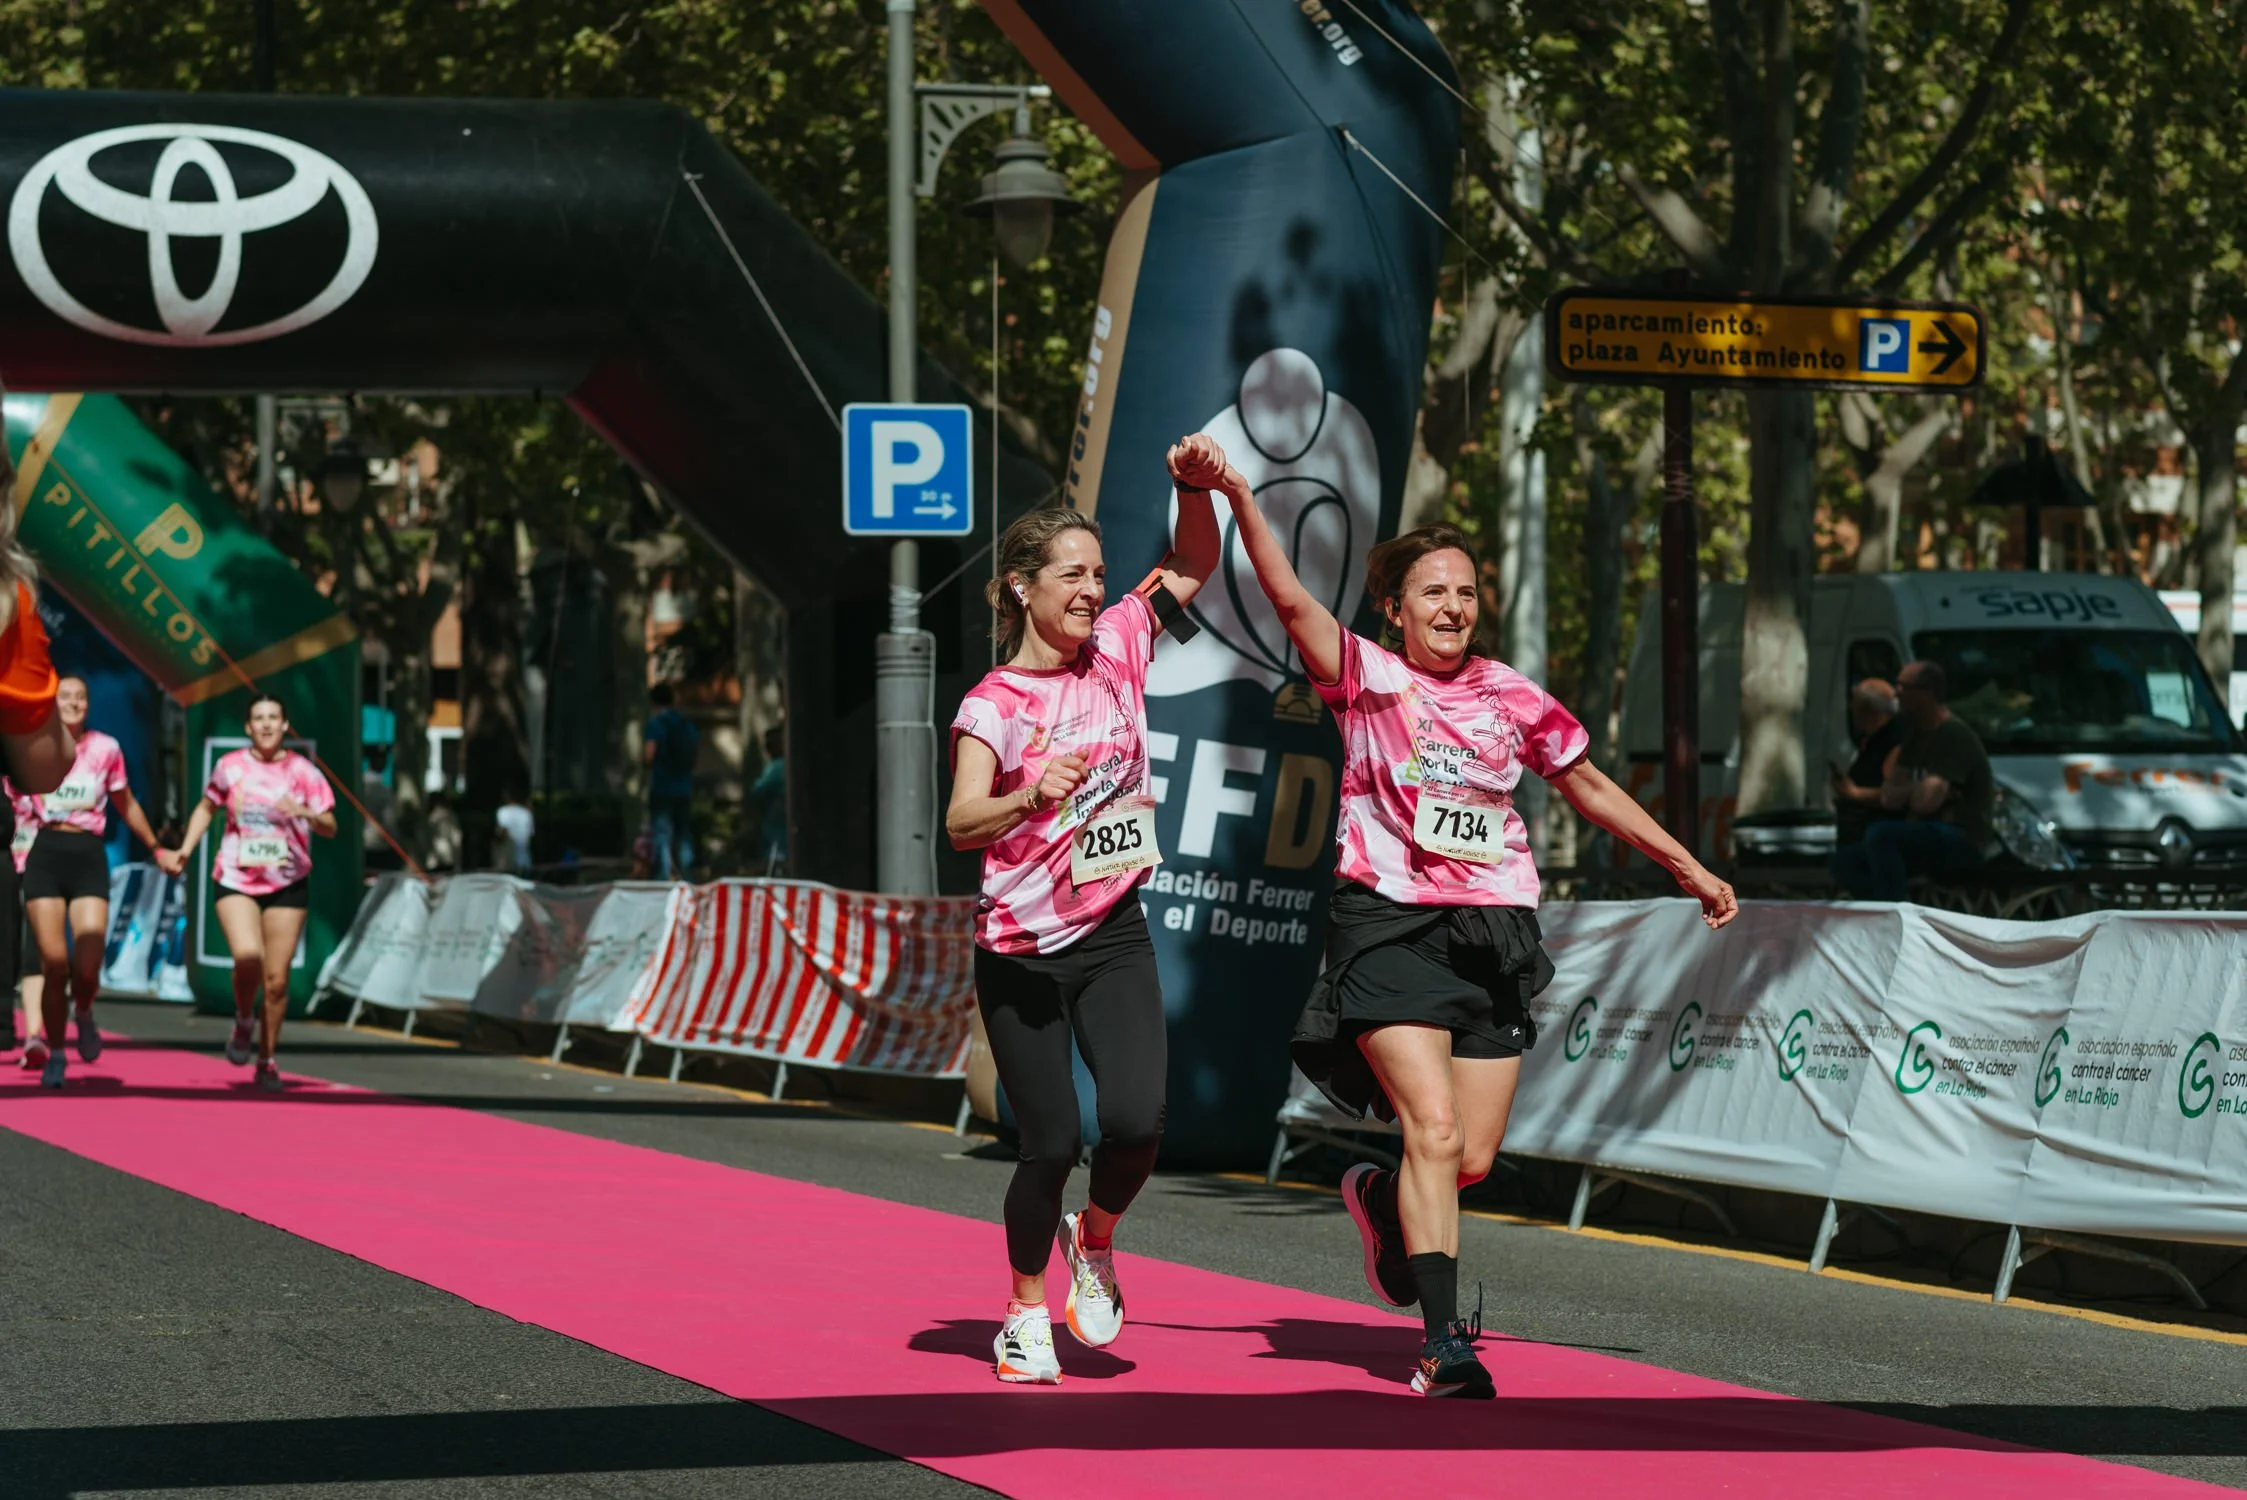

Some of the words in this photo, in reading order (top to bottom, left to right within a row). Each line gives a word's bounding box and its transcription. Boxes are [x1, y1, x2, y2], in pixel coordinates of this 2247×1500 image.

[1301, 0, 1363, 66] er.org
[1568, 311, 1763, 338] aparcamiento:
[1568, 339, 1639, 365] plaza
[1657, 341, 1846, 371] Ayuntamiento
[1867, 322, 1901, 369] P
[871, 420, 945, 518] P
[43, 482, 217, 665] PITILLOS
[1417, 717, 1433, 732] XI
[1417, 736, 1476, 759] Carrera
[1087, 754, 1121, 780] rrera
[1444, 759, 1458, 775] la
[1074, 786, 1099, 807] por
[1101, 780, 1115, 793] la
[1432, 806, 1488, 842] 7134
[1083, 818, 1142, 860] 2825
[1247, 879, 1315, 910] Ferrer
[1163, 903, 1196, 932] el
[1210, 907, 1308, 945] Deporte
[1948, 1033, 1998, 1052] asociación
[1999, 1035, 2040, 1056] española
[2077, 1036, 2130, 1057] asociación
[2131, 1038, 2178, 1061] española
[1942, 1056, 1974, 1073] contra
[1975, 1057, 1986, 1075] el
[2071, 1061, 2104, 1079] contra
[2104, 1061, 2115, 1080] el
[1935, 1081, 1950, 1094] en
[1950, 1079, 1964, 1096] La
[1963, 1080, 1987, 1101] Rioja
[2223, 1072, 2247, 1088] con
[2065, 1088, 2077, 1104] en
[2078, 1086, 2093, 1105] La
[2094, 1087, 2119, 1110] Rioja
[2216, 1098, 2232, 1113] en
[2233, 1095, 2247, 1114] La
